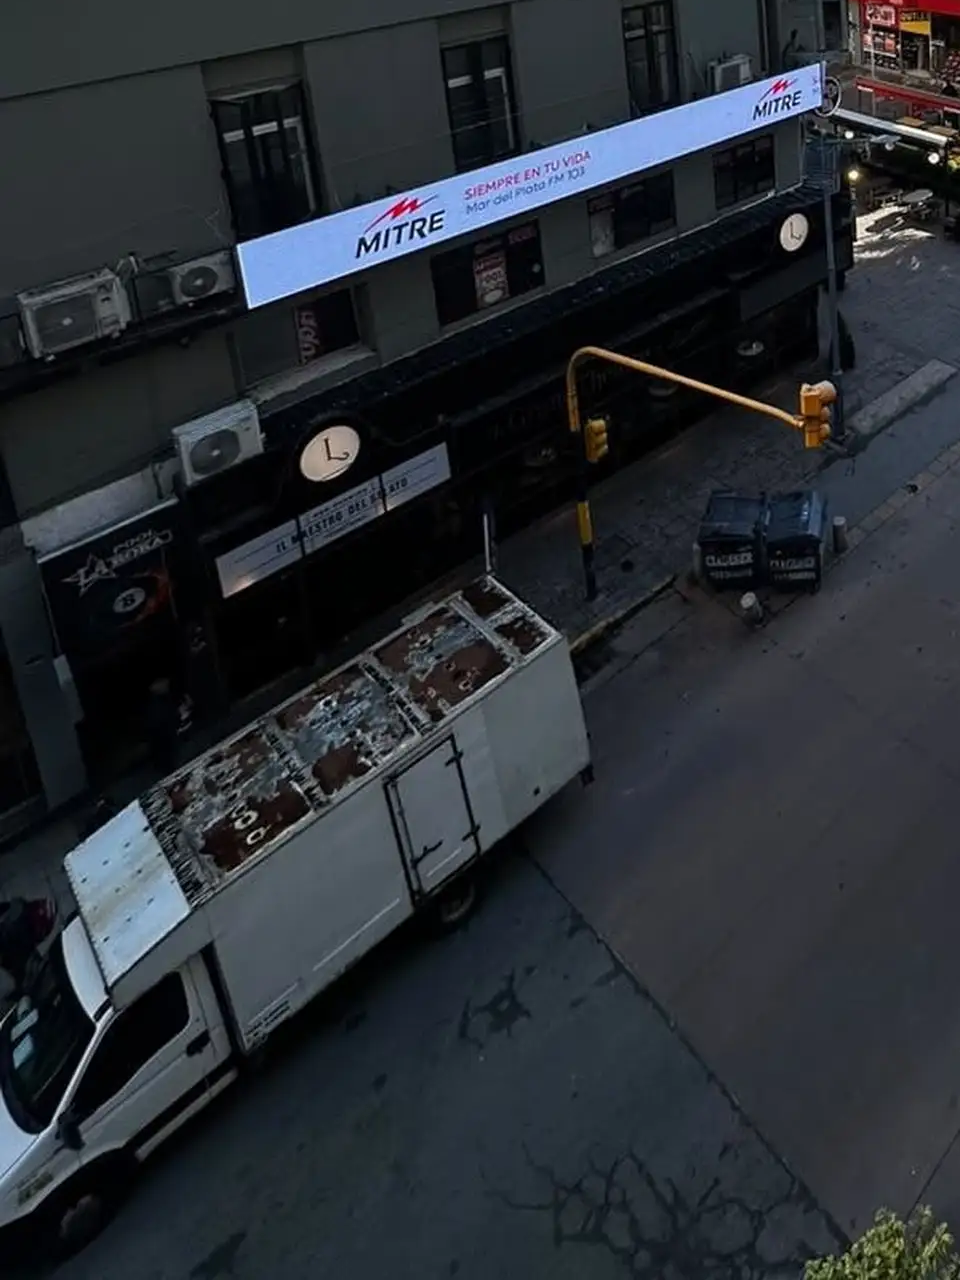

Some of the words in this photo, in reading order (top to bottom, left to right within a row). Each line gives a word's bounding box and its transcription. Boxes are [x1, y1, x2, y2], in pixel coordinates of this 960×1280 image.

[752, 89, 803, 121] MITRE
[464, 174, 521, 200] SIEMPRE
[523, 166, 541, 181] EN
[544, 160, 560, 174] TU
[562, 150, 592, 167] VIDA
[466, 199, 490, 214] Mar
[493, 189, 513, 205] del
[514, 180, 546, 197] Plata
[548, 172, 565, 186] FM
[355, 209, 446, 259] MITRE
